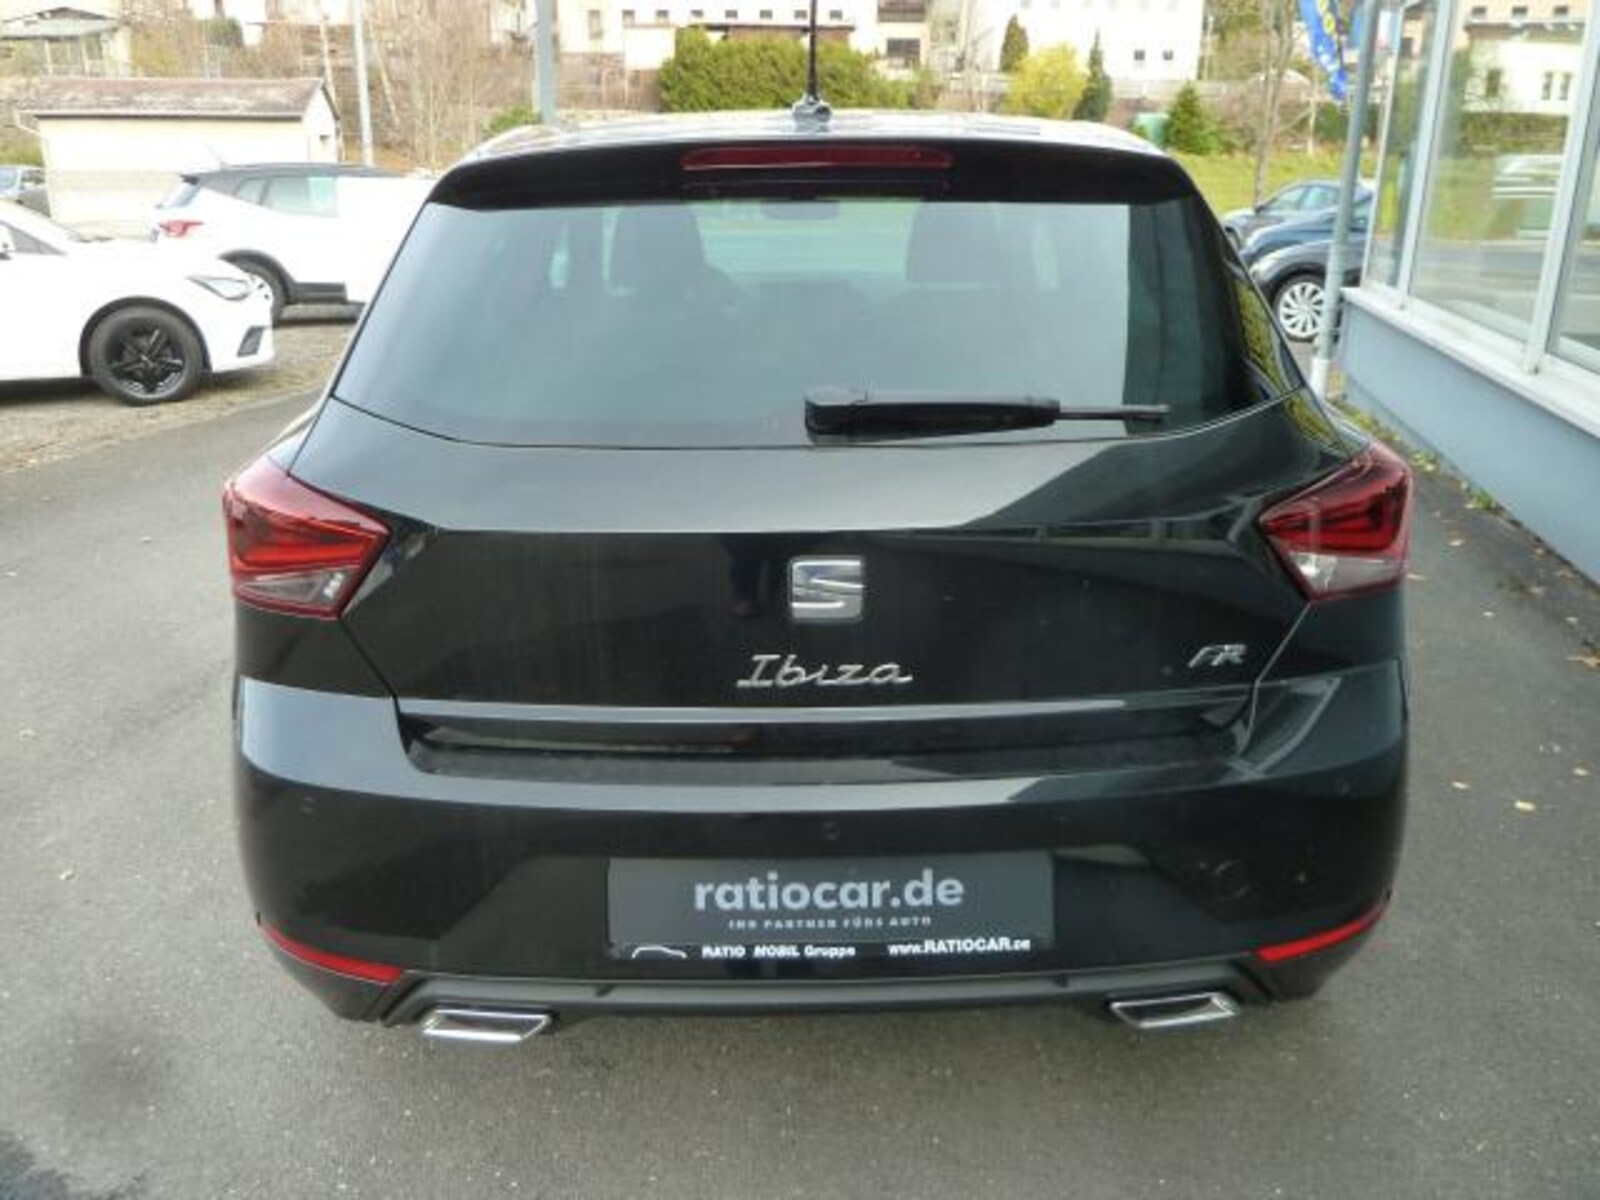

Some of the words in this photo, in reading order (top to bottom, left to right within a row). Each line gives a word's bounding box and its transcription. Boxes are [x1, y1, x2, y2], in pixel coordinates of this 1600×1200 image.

[1189, 644, 1246, 668] FR
[736, 654, 913, 688] Ibiza
[694, 868, 964, 911] ratiocar.de
[728, 919, 757, 930] IHR
[764, 918, 836, 929] PARTNER
[843, 916, 883, 928] FÜRS
[889, 916, 931, 927] AUTO
[702, 945, 746, 959] RATIO
[753, 944, 800, 958] MOBIL
[804, 944, 856, 959] Gruppe
